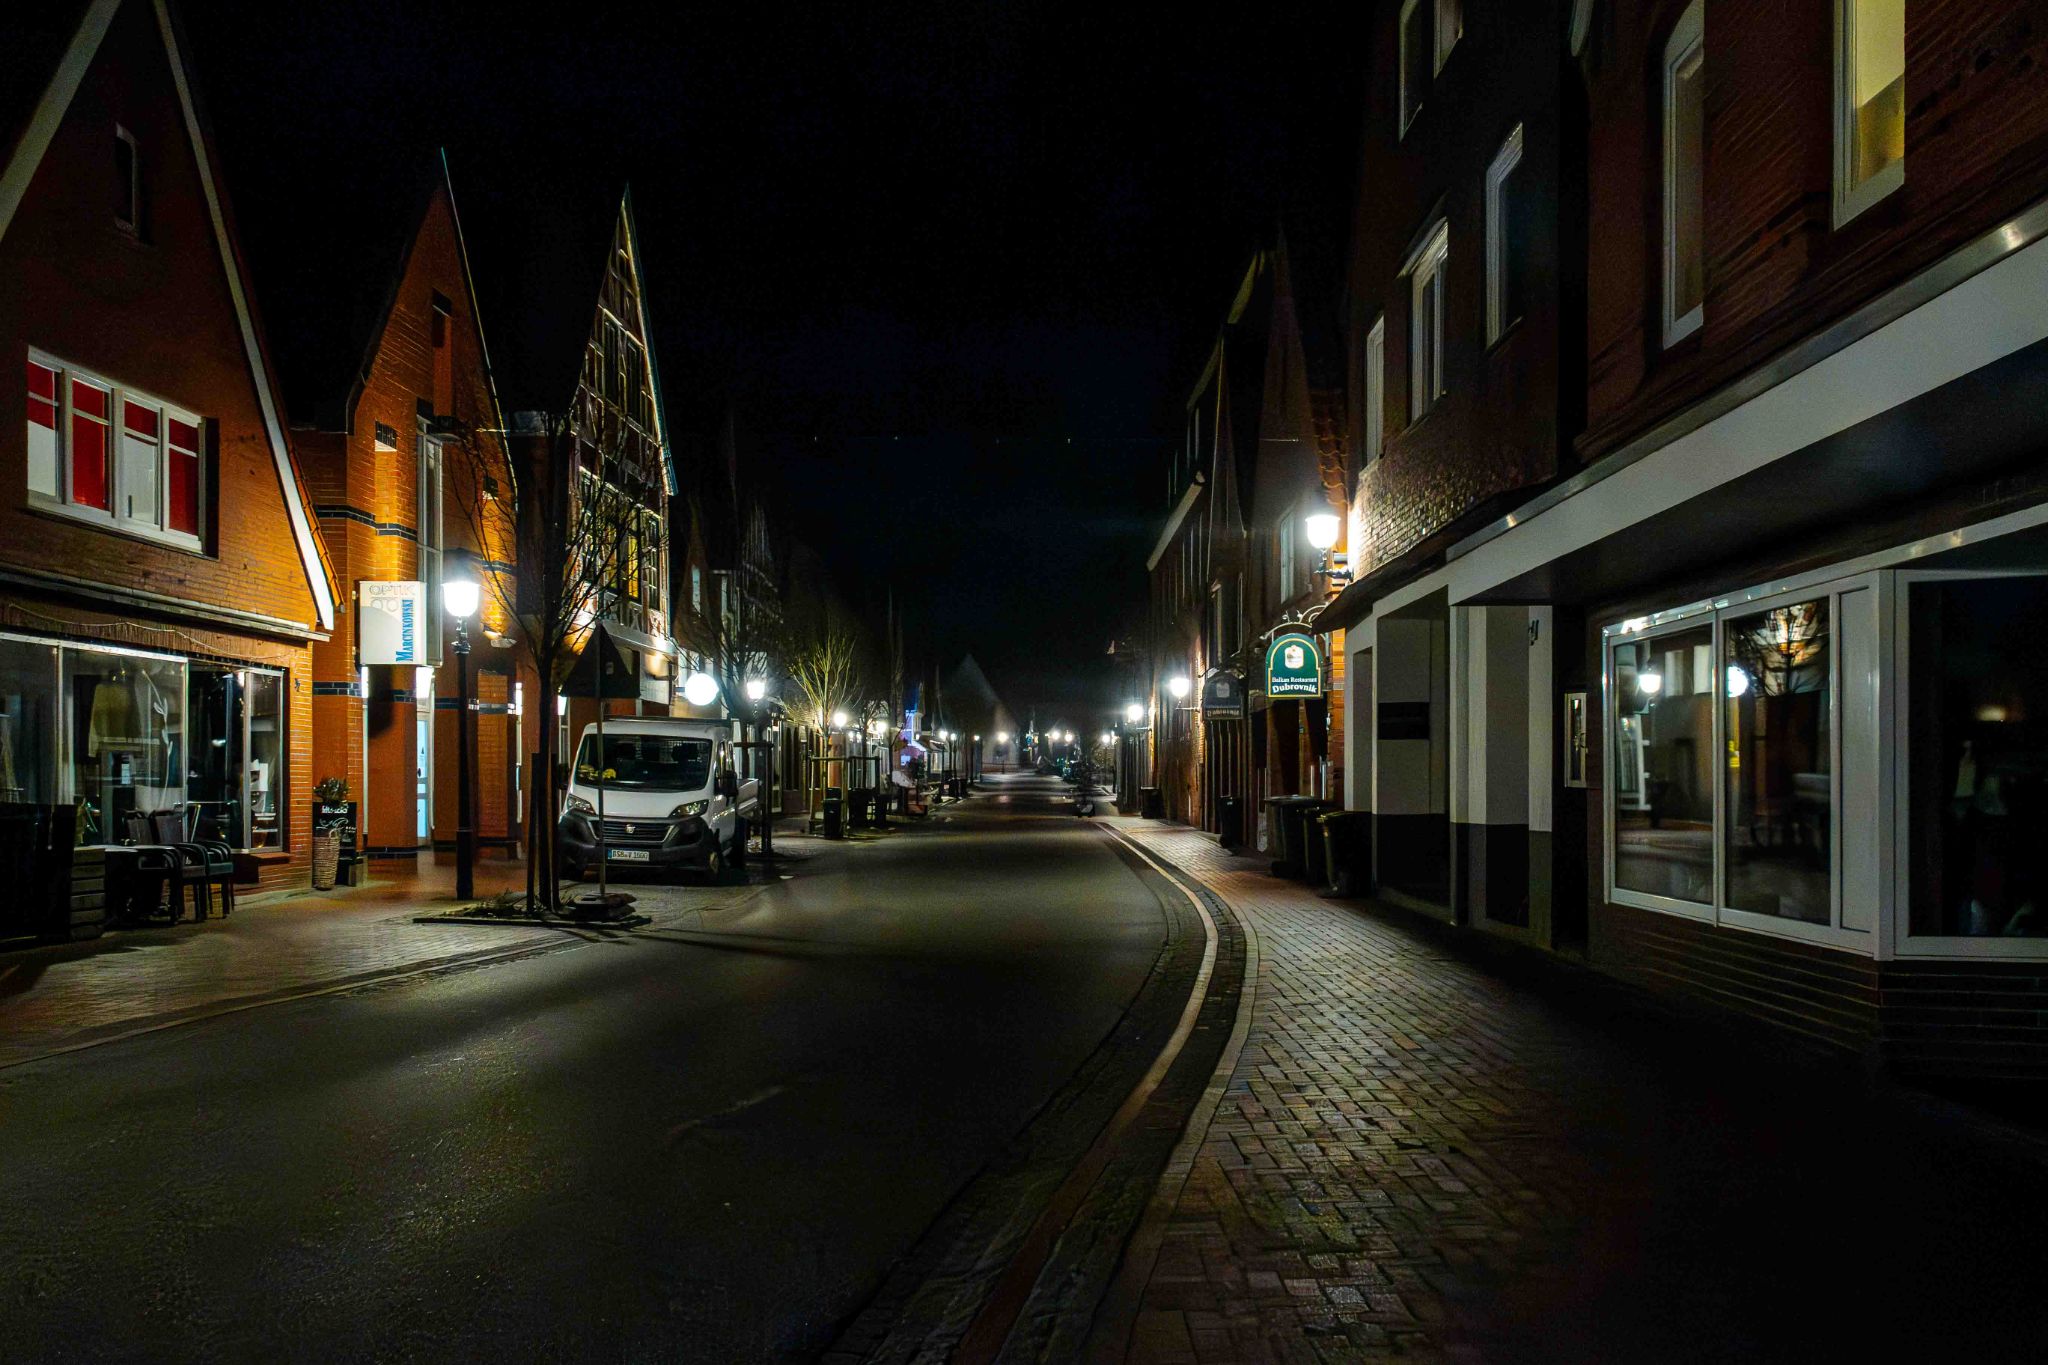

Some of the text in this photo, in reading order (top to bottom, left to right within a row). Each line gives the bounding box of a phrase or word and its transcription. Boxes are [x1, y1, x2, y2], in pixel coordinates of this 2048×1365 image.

[369, 585, 415, 595] OPTIK
[396, 600, 413, 661] MARCINKOWSKI
[1272, 683, 1317, 693] Dubrovnik
